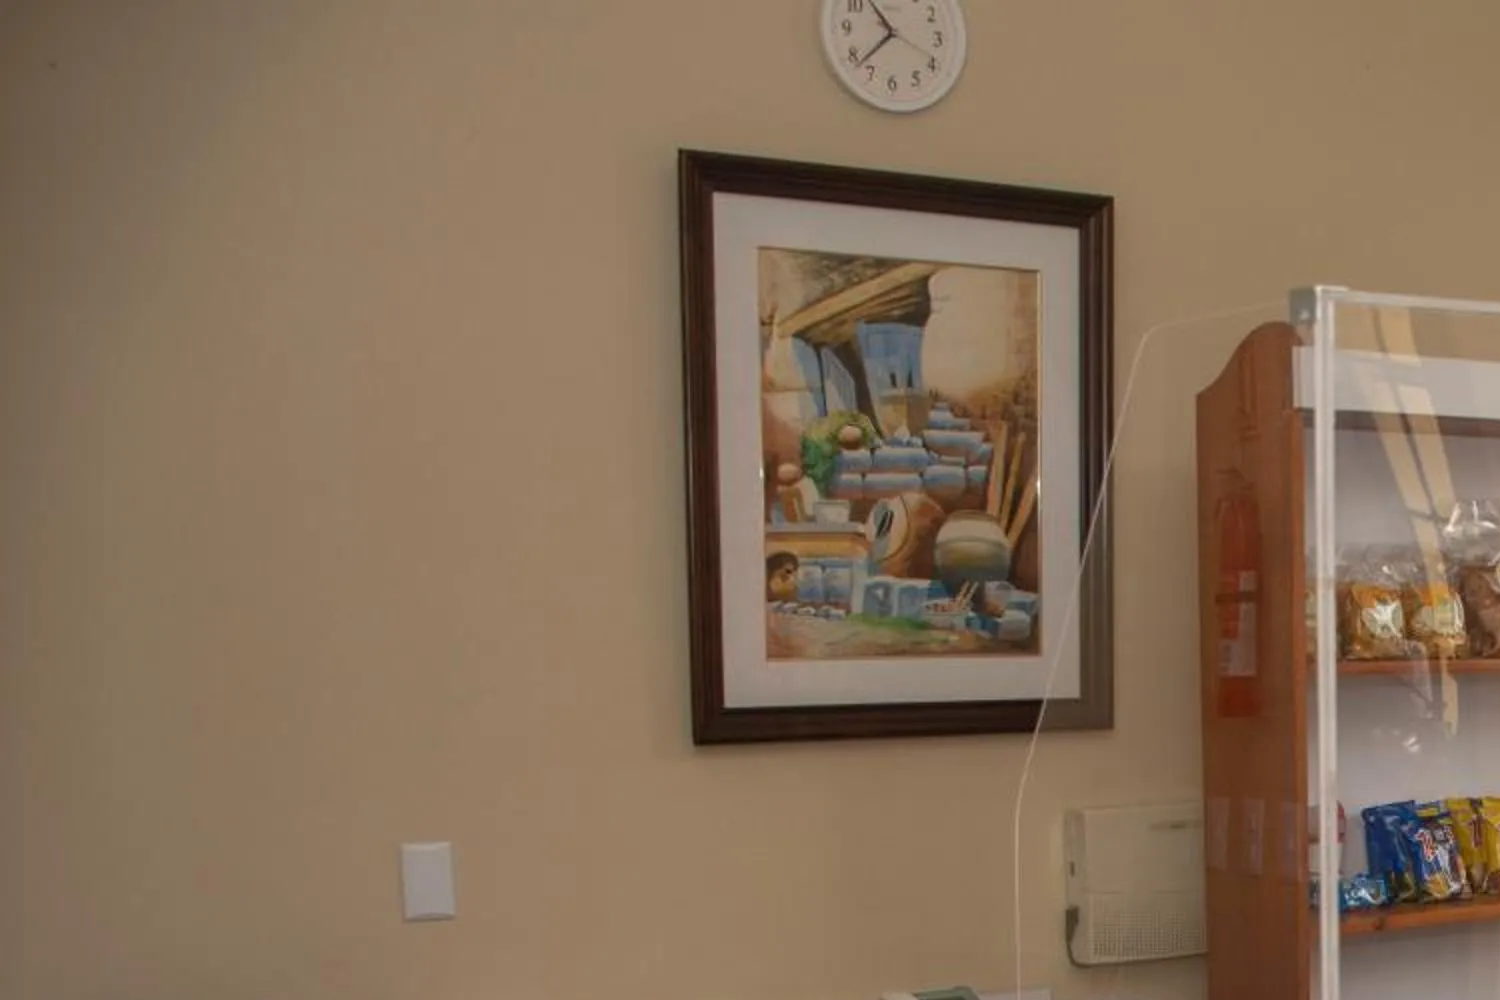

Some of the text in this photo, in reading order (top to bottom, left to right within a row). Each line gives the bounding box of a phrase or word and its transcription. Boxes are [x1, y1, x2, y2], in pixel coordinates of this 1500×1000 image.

[926, 6, 936, 23] 2
[841, 19, 852, 36] 9
[932, 31, 943, 48] 3
[927, 55, 936, 72] 4
[866, 65, 875, 81] 7
[911, 70, 921, 87] 5
[887, 75, 897, 91] 6
